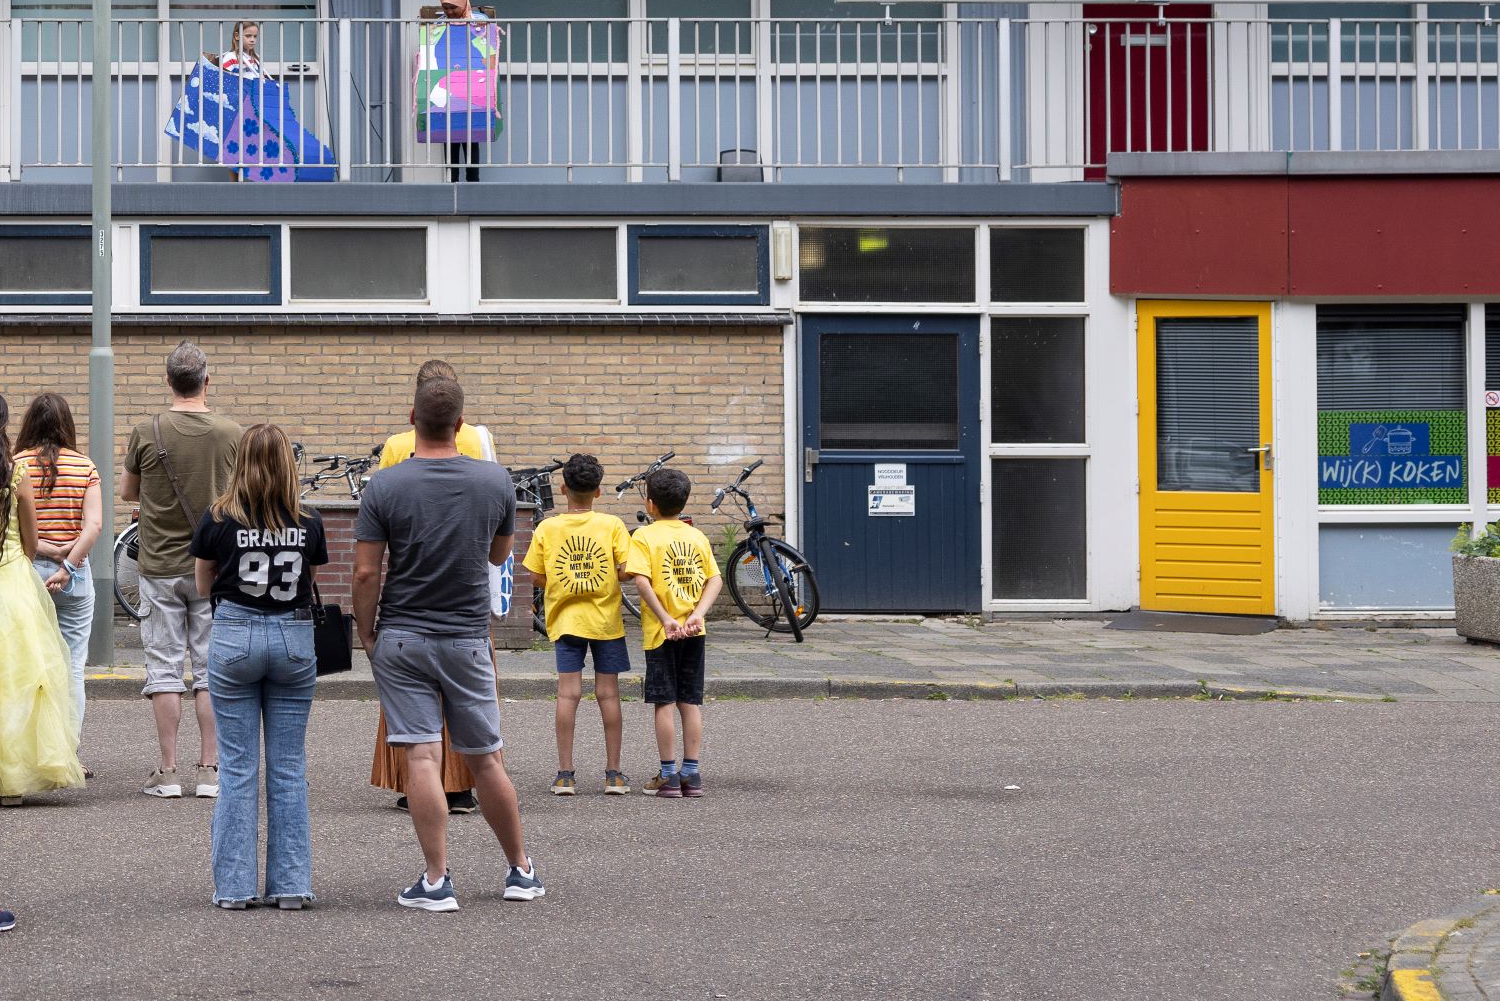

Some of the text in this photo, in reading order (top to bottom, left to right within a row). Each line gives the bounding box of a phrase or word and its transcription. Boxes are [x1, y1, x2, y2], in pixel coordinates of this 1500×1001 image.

[1388, 459, 1460, 485] KOKEN
[236, 527, 307, 548] GRANDE
[570, 552, 592, 562] LOOP JE
[570, 563, 581, 571] MET
[238, 551, 303, 601] 93
[575, 571, 591, 579] MEE?
